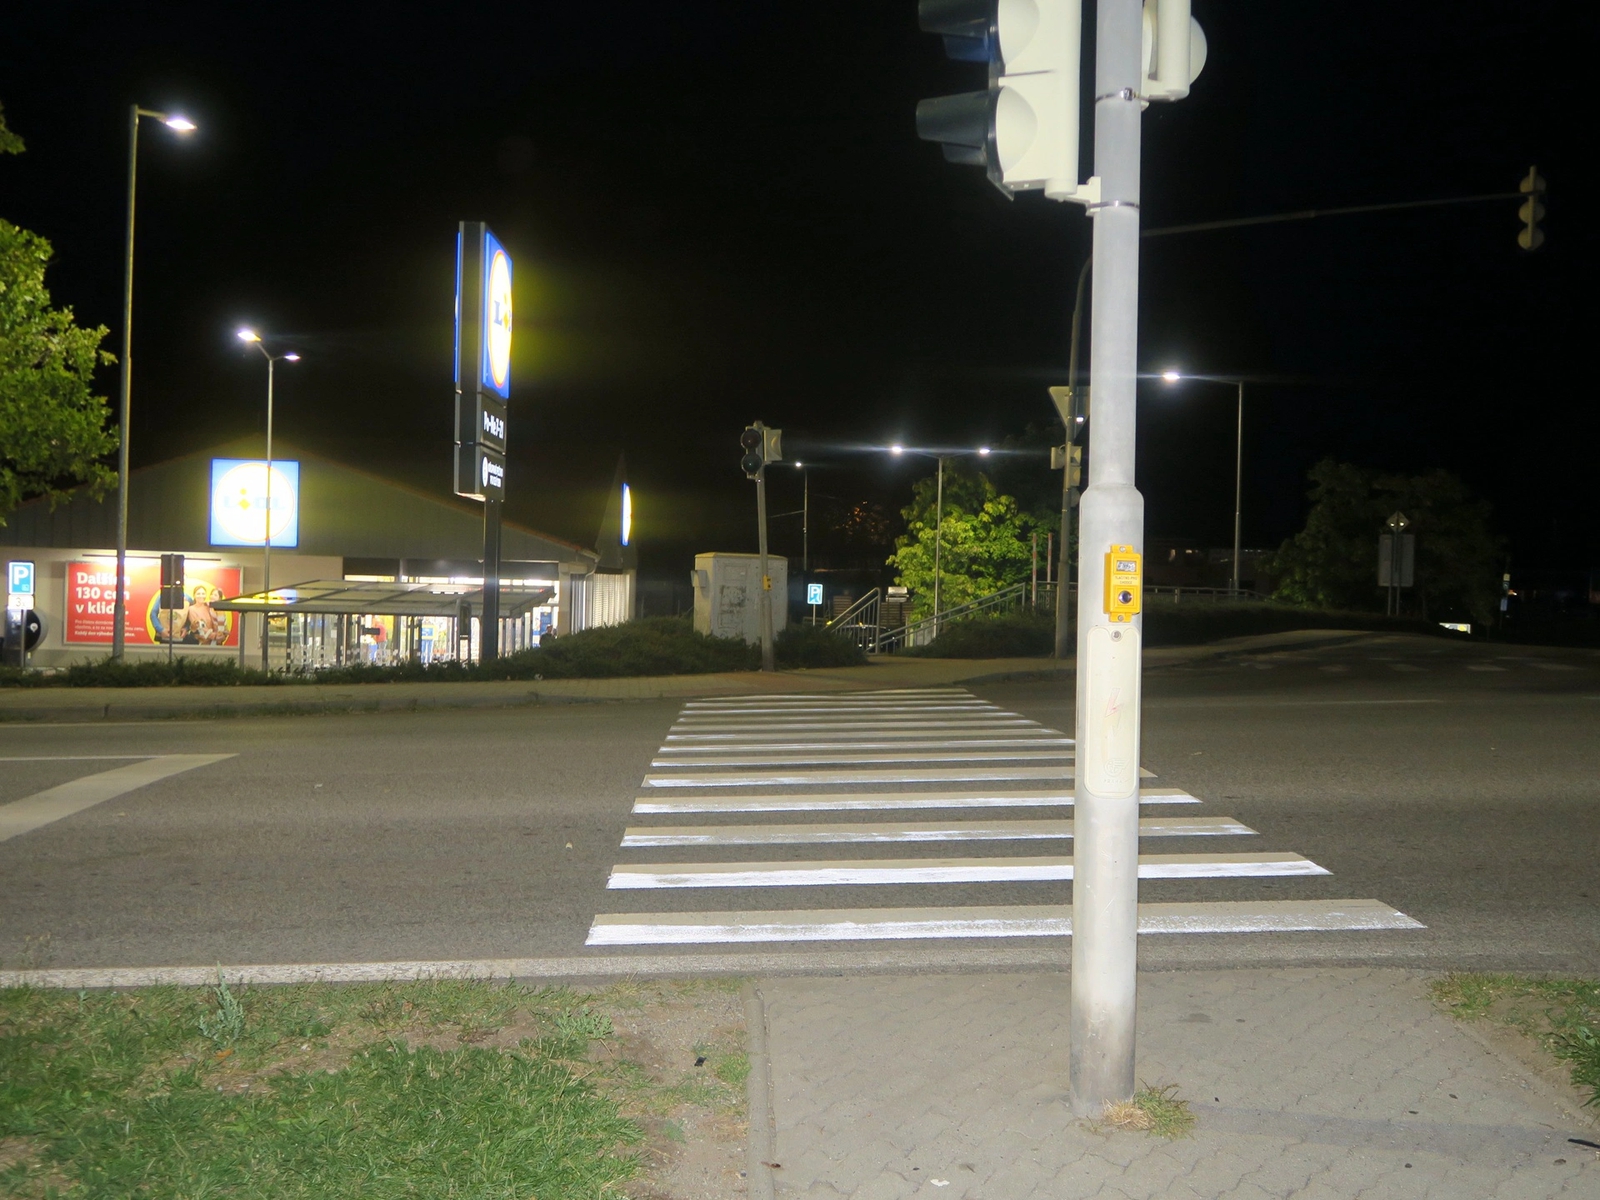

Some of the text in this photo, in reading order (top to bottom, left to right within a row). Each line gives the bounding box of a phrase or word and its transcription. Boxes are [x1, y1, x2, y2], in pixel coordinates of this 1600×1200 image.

[13, 566, 29, 585] P
[76, 586, 101, 599] 130
[75, 601, 129, 615] v klid.
